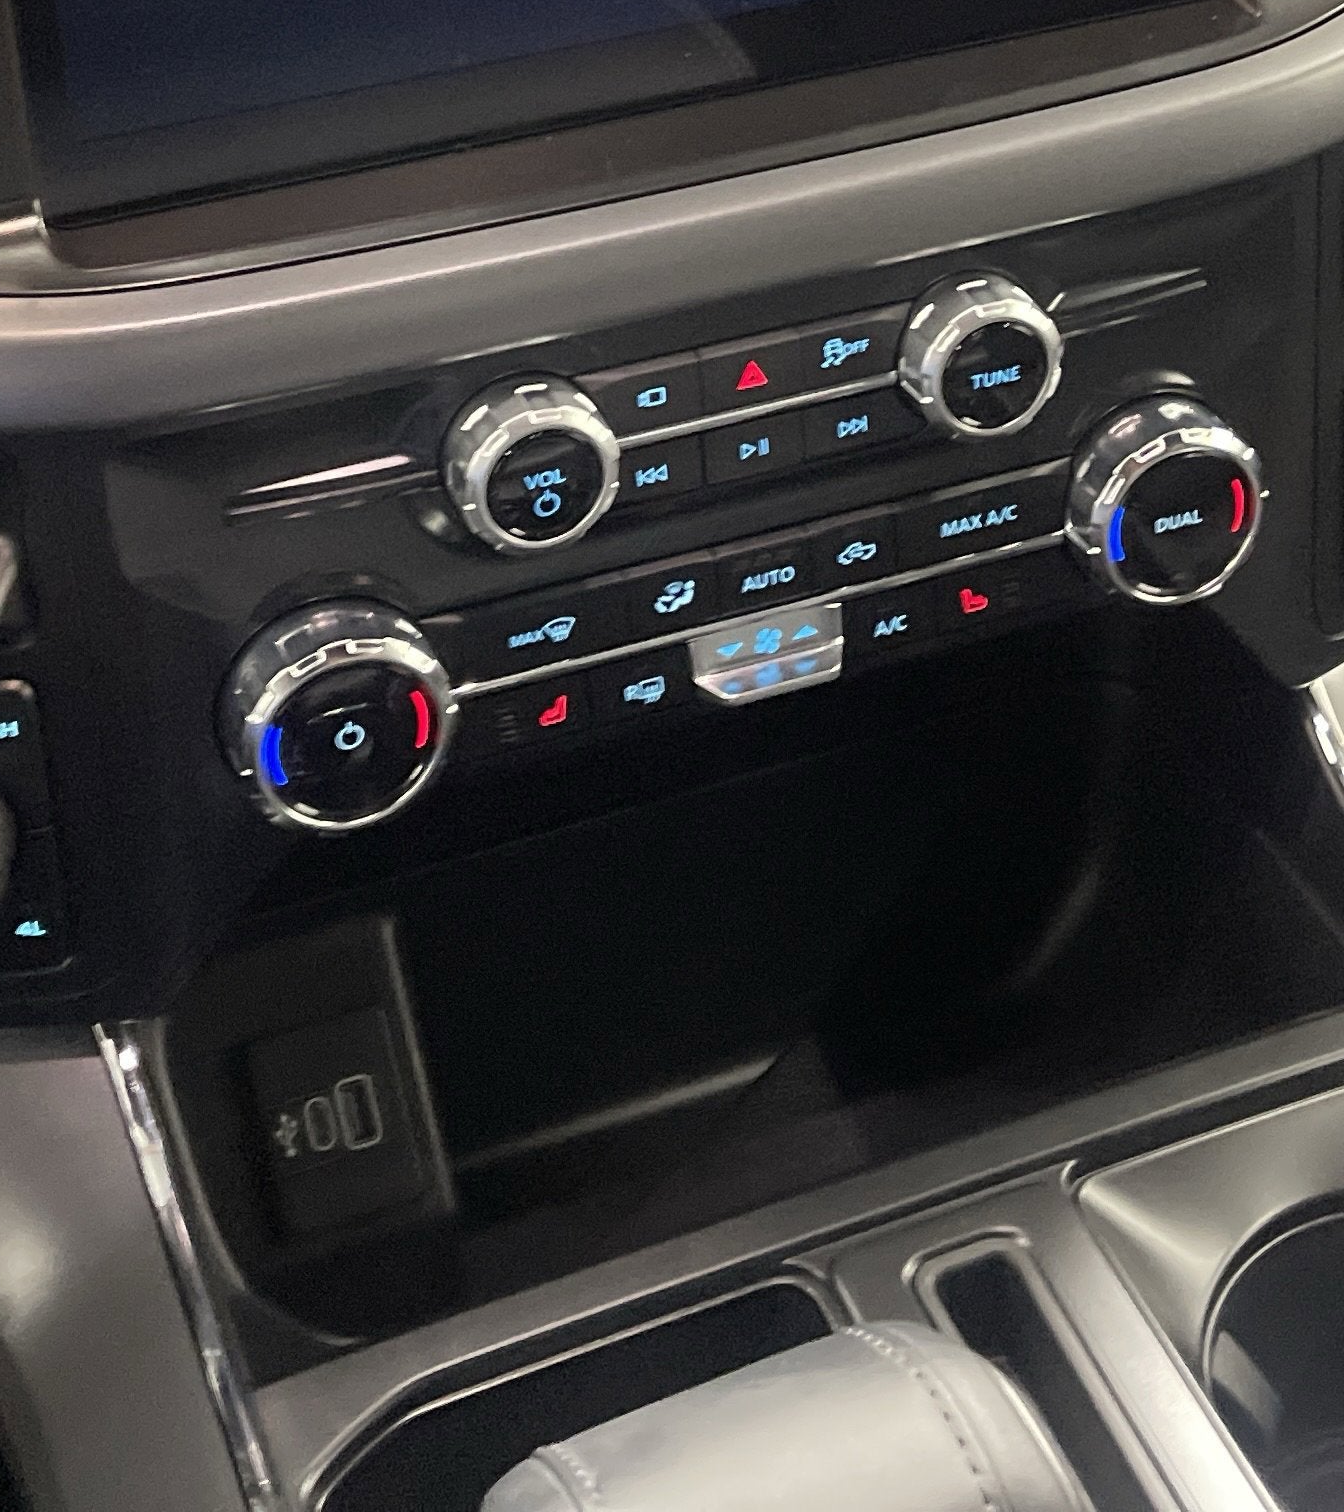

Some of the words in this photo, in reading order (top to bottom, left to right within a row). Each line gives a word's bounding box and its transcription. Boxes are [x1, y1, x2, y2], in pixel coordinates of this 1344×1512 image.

[843, 337, 870, 356] OFF
[969, 364, 1022, 390] TUNE
[523, 467, 567, 490] VOL
[939, 512, 983, 539] MAX
[983, 503, 1019, 528] A/C
[1153, 508, 1204, 535] DUAL
[740, 564, 796, 594] AUTO
[872, 614, 908, 638] A/C
[507, 630, 546, 649] MAX
